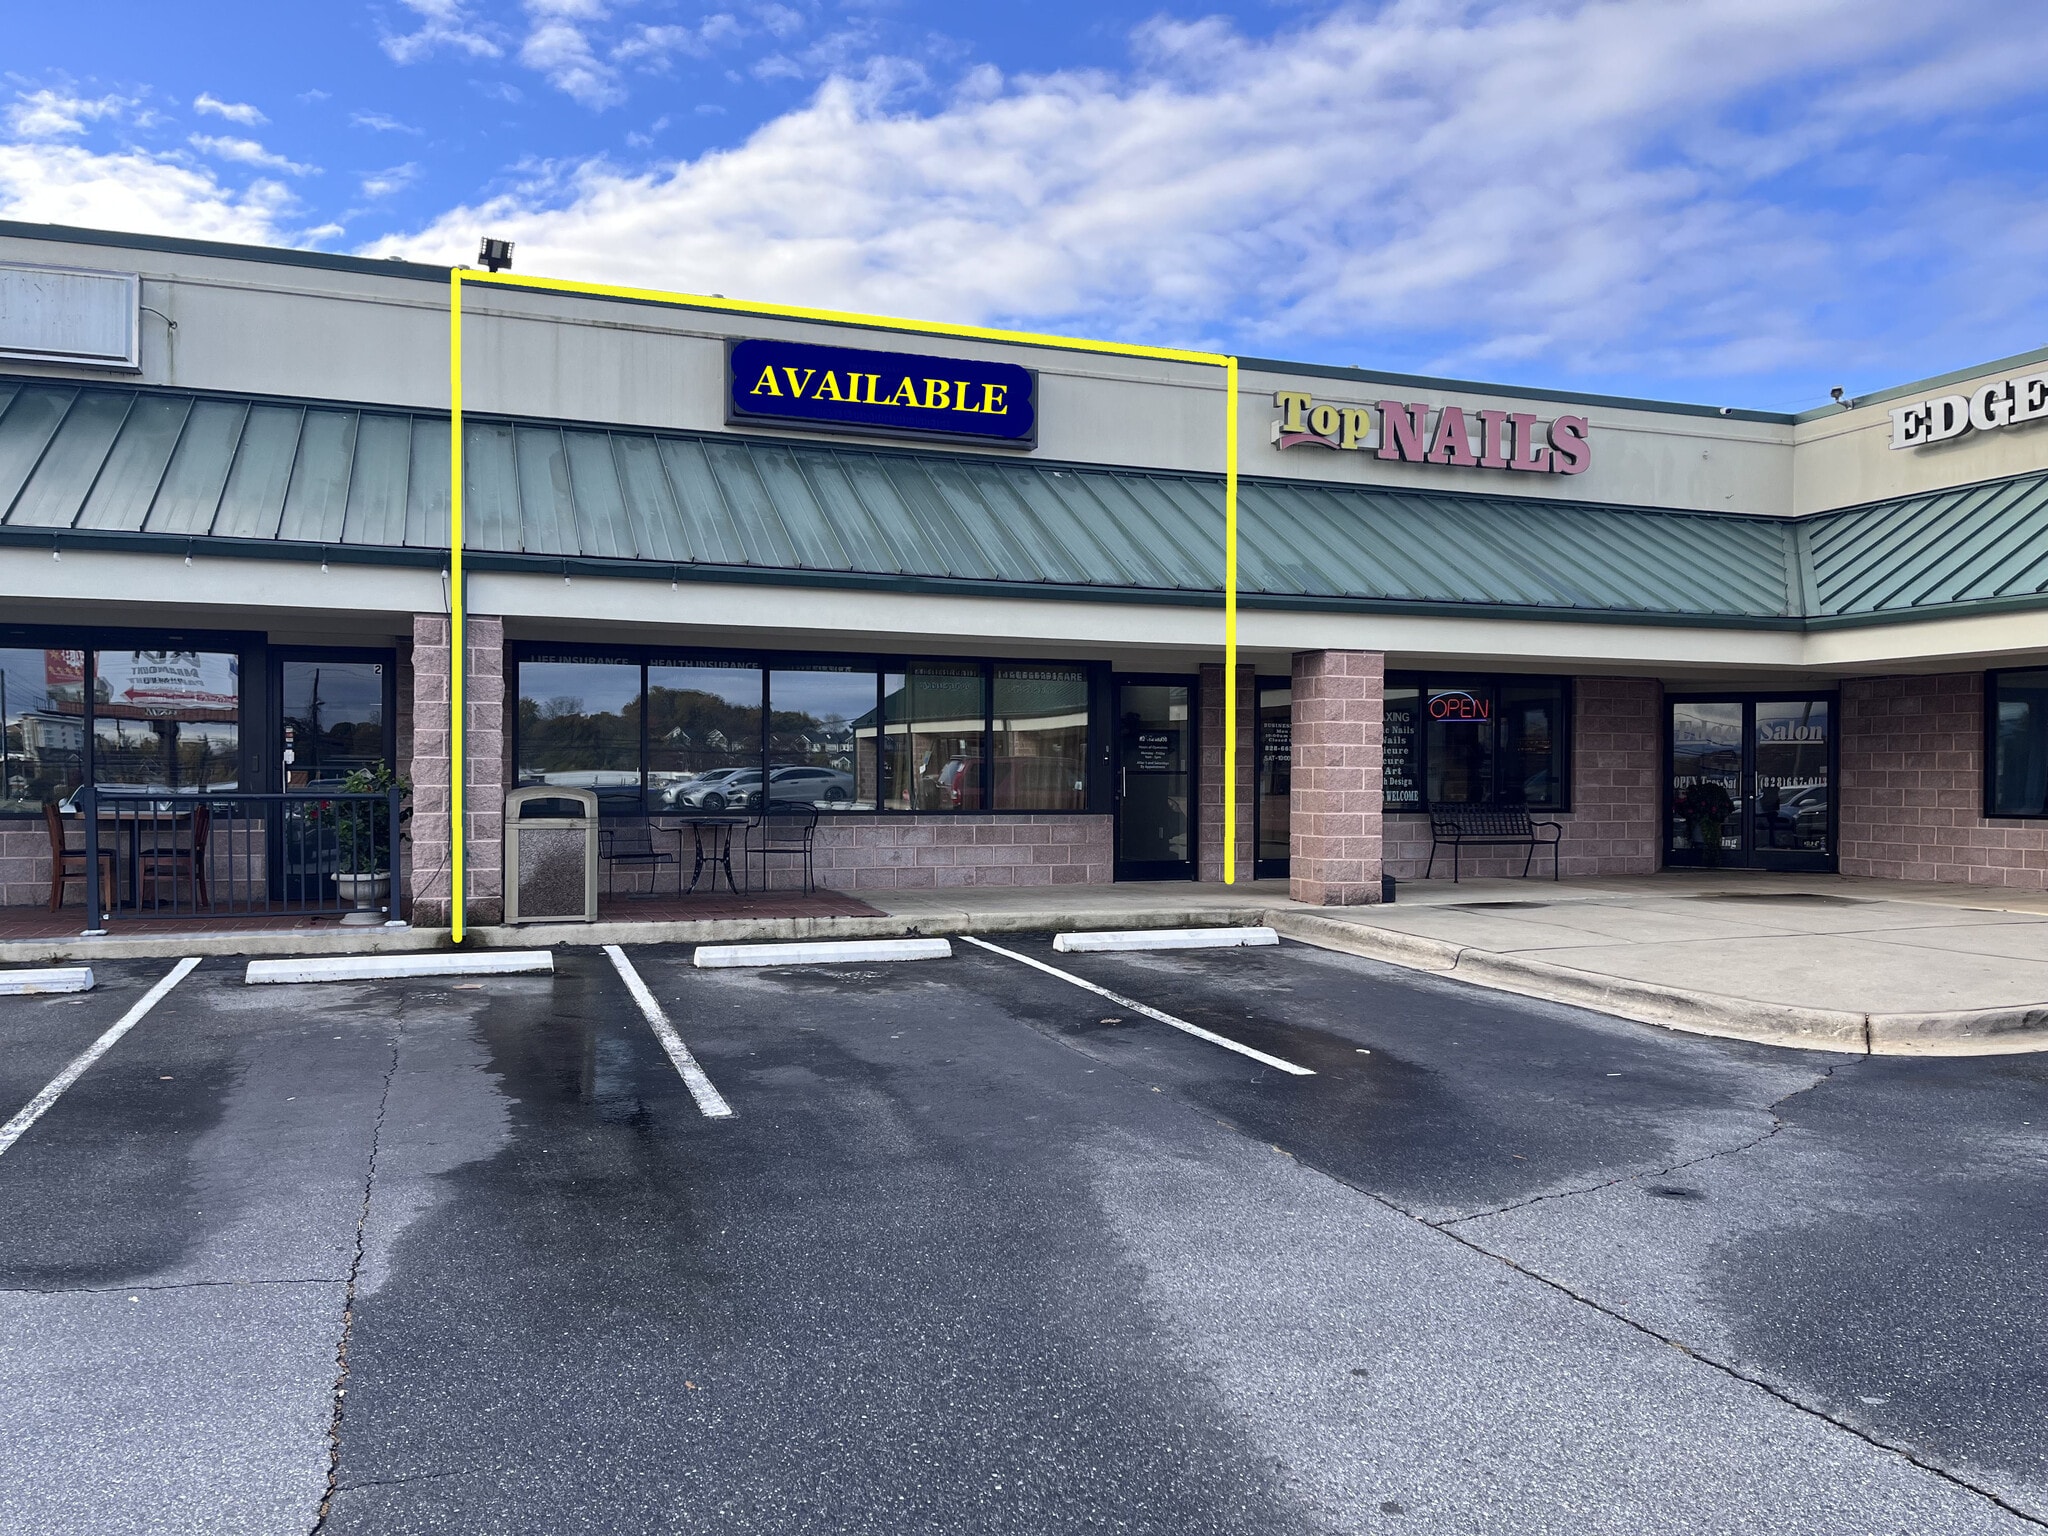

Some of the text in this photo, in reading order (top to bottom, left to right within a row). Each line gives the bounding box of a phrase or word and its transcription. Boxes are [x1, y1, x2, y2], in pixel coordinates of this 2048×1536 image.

[1888, 371, 2048, 450] EDGE
[1274, 391, 1591, 475] Top NAILS
[558, 655, 629, 666] INSURANCE
[649, 658, 759, 670] HEALTH INSURANCE
[374, 665, 381, 675] 2
[1429, 698, 1490, 718] OPEN
[1384, 711, 1410, 722] XING
[1391, 725, 1415, 735] Nails
[1759, 720, 1824, 741] Salon
[1383, 747, 1409, 755] icure
[1385, 766, 1402, 775] Art
[1389, 776, 1413, 787] Design
[1386, 790, 1419, 802] WELCOME
